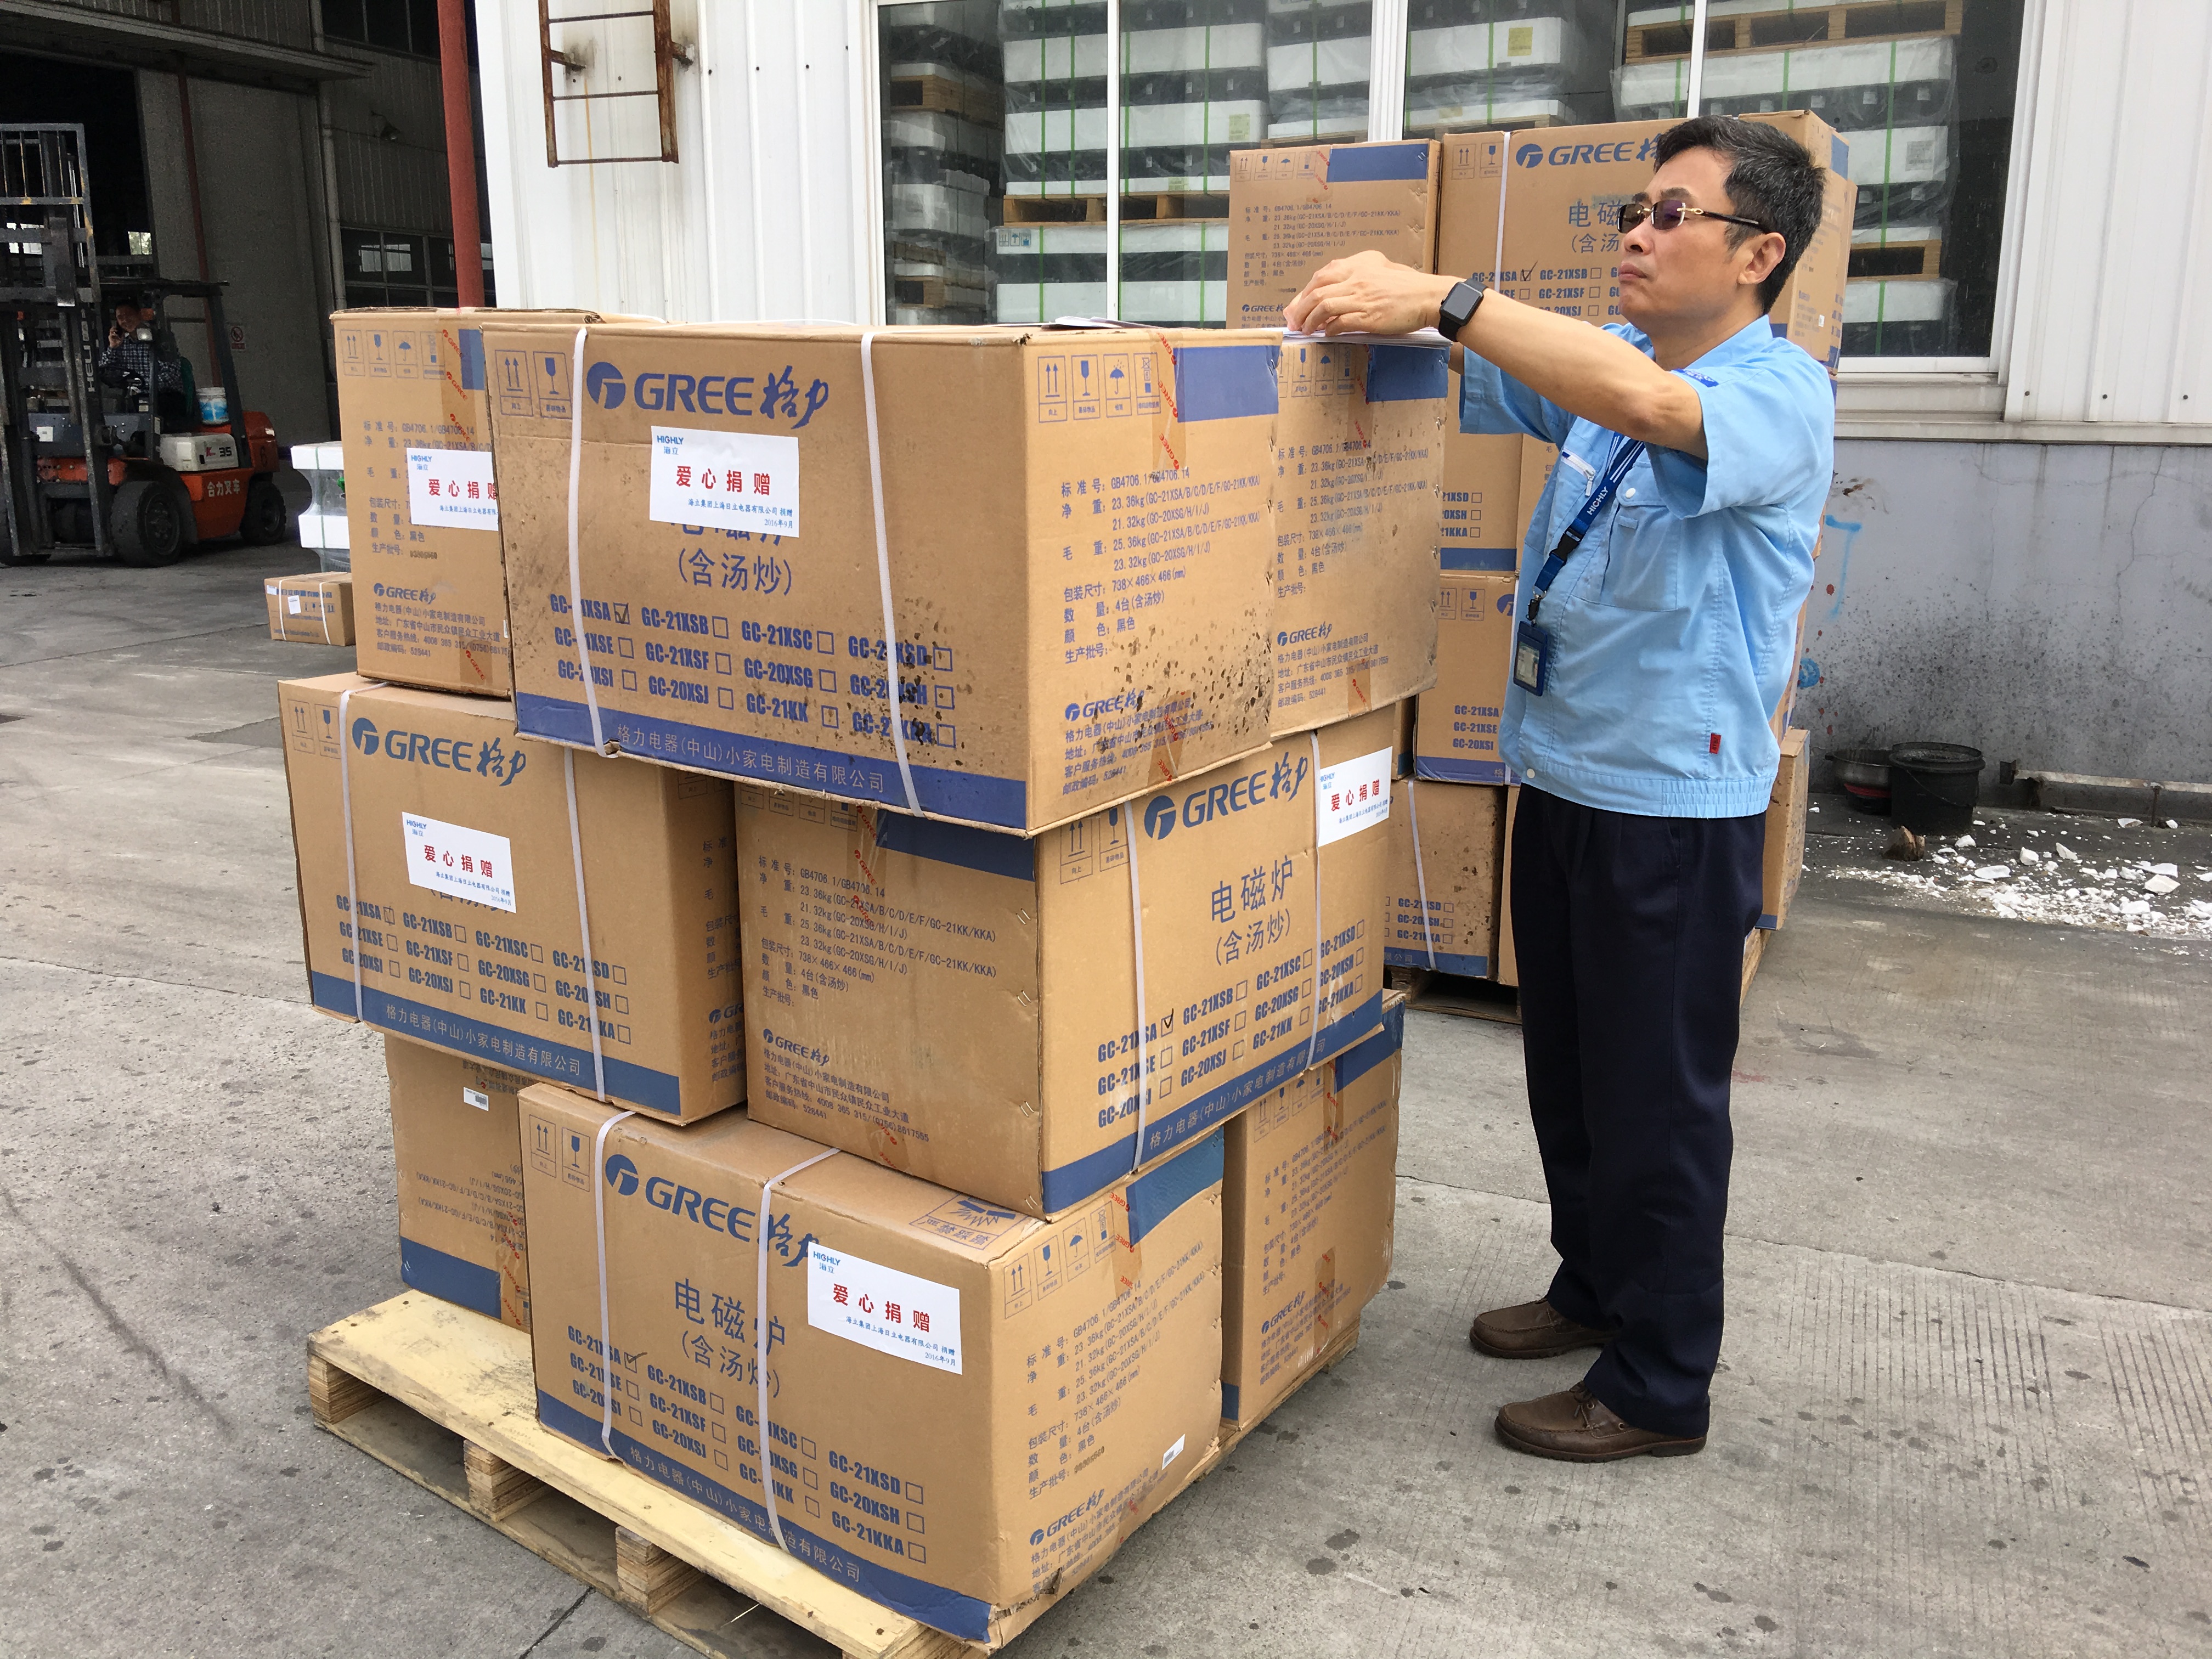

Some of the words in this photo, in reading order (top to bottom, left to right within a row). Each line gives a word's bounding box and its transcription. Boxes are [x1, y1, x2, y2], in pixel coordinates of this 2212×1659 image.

[1548, 141, 1635, 166] GREE
[1540, 268, 1588, 280] GC-21XSB
[1539, 287, 1584, 299] GC-21XSF
[634, 372, 754, 416] GREE
[219, 447, 232, 457] 35
[657, 435, 684, 445] HIGHLY
[663, 446, 679, 456] 海立
[207, 478, 240, 498] 合力叉车
[676, 465, 771, 496] 爱心捐赠
[687, 498, 778, 516] 海立集团上海日立电器有限公司
[1587, 486, 1609, 515] HIGHLY
[764, 518, 794, 530] 2016年9月
[678, 548, 792, 596] (含汤炒)
[386, 586, 418, 601] GREE
[642, 607, 708, 635] GC-21XSB
[742, 620, 813, 651] GC-21XSC
[1116, 617, 1135, 633] 黑色
[1289, 626, 1318, 644] GREE
[645, 642, 709, 670] GC-21XSF
[744, 658, 814, 689] GC-20XSG
[648, 676, 709, 704] GC-20XSJ
[746, 693, 809, 723] GC-21KK
[1082, 695, 1125, 718] GREE
[1454, 705, 1499, 717] GC-21XSA
[1454, 721, 1497, 733] GC-21XSE
[385, 730, 473, 772] GREE
[617, 724, 884, 793] 格力电器(中山)小家电制造有限公司
[1453, 738, 1493, 751] GC-20XSI
[1182, 769, 1267, 829] GREE
[1331, 779, 1380, 811] 爱心捐赠
[407, 819, 427, 830] HIGHLY
[424, 845, 493, 878] 爱心捐赠
[859, 860, 877, 885] GREE
[1211, 854, 1293, 925] 电磁炉
[403, 912, 452, 938] GC-21XSB
[476, 930, 528, 958] GC-21XSC
[1215, 908, 1290, 967] (含汤炒)
[406, 940, 453, 966] GC-21XSF
[478, 960, 530, 988] GC-20XSG
[408, 967, 453, 993] GC-20XSJ
[479, 988, 527, 1014] GC-21KK
[802, 984, 819, 1000] 黑色
[1183, 988, 1233, 1026] GC-21XSB
[1256, 955, 1301, 991] GC-21XSC
[1182, 1018, 1231, 1057] GC-21XSF
[1255, 985, 1299, 1022] GC-20XSG
[386, 1004, 580, 1076] 格力电器(中山)小家电制造有限公司
[775, 1036, 809, 1058] GREE
[1181, 1048, 1227, 1088] GC-20XSJ
[1252, 1015, 1293, 1051] GC-21KK
[645, 1176, 756, 1243] GREE
[918, 1217, 991, 1246] 严禁踩踏
[813, 1251, 841, 1266] HIGHLY
[819, 1262, 834, 1274] 海立
[675, 1278, 786, 1356] 电磁炉
[833, 1283, 930, 1333] 爱心捐赠
[845, 1316, 939, 1352] 海立集团上海日立电器有限公司
[925, 1352, 956, 1366] 2016年9月
[647, 1364, 707, 1406] GC-21XSB
[736, 1404, 798, 1449] GC-1XSC
[829, 1450, 900, 1495] GC-21XSD
[650, 1392, 706, 1433] GC-21XSF
[830, 1481, 900, 1526] GC-20XSH
[652, 1419, 707, 1459] GC-20XSJ
[832, 1511, 904, 1556] GC-21KKA
[1047, 1503, 1086, 1537] GREE
